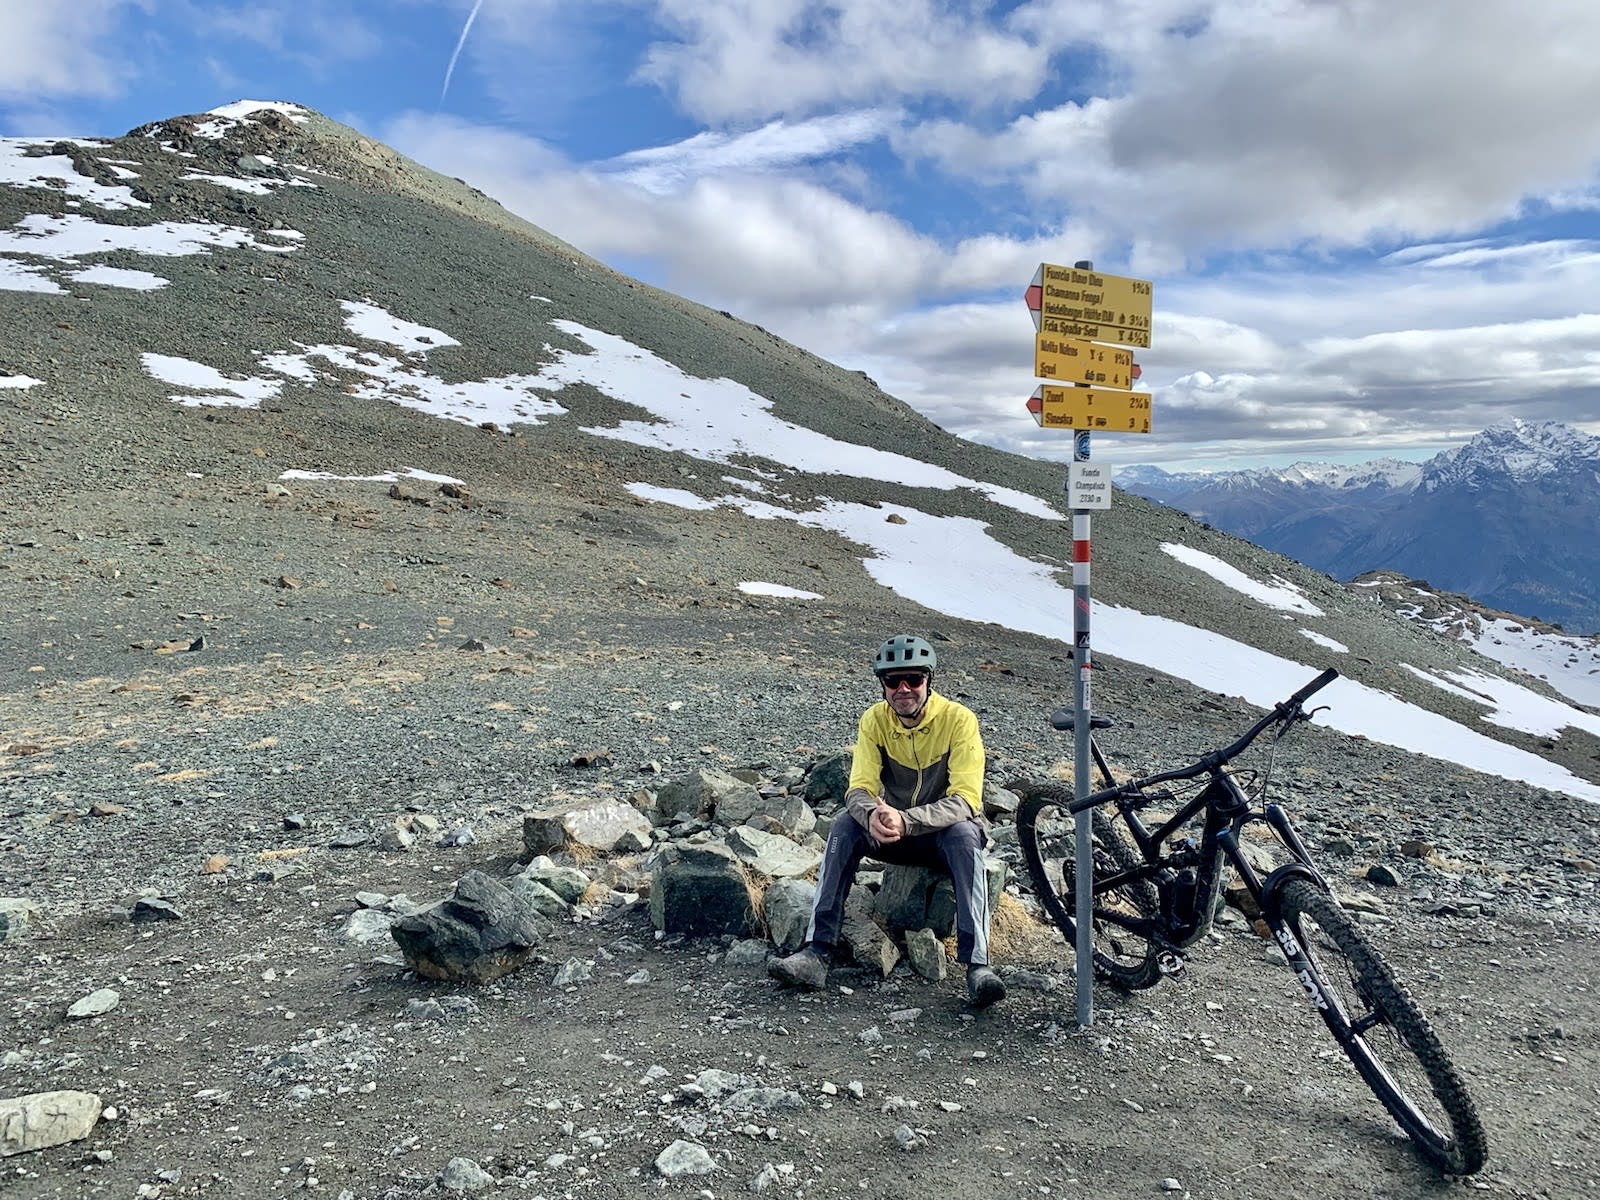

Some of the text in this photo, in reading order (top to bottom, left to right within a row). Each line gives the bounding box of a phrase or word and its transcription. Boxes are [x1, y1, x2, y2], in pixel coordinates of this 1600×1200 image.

[1046, 284, 1080, 301] Chamanna
[1045, 302, 1083, 320] Heidelberger
[1129, 417, 1135, 428] 3
